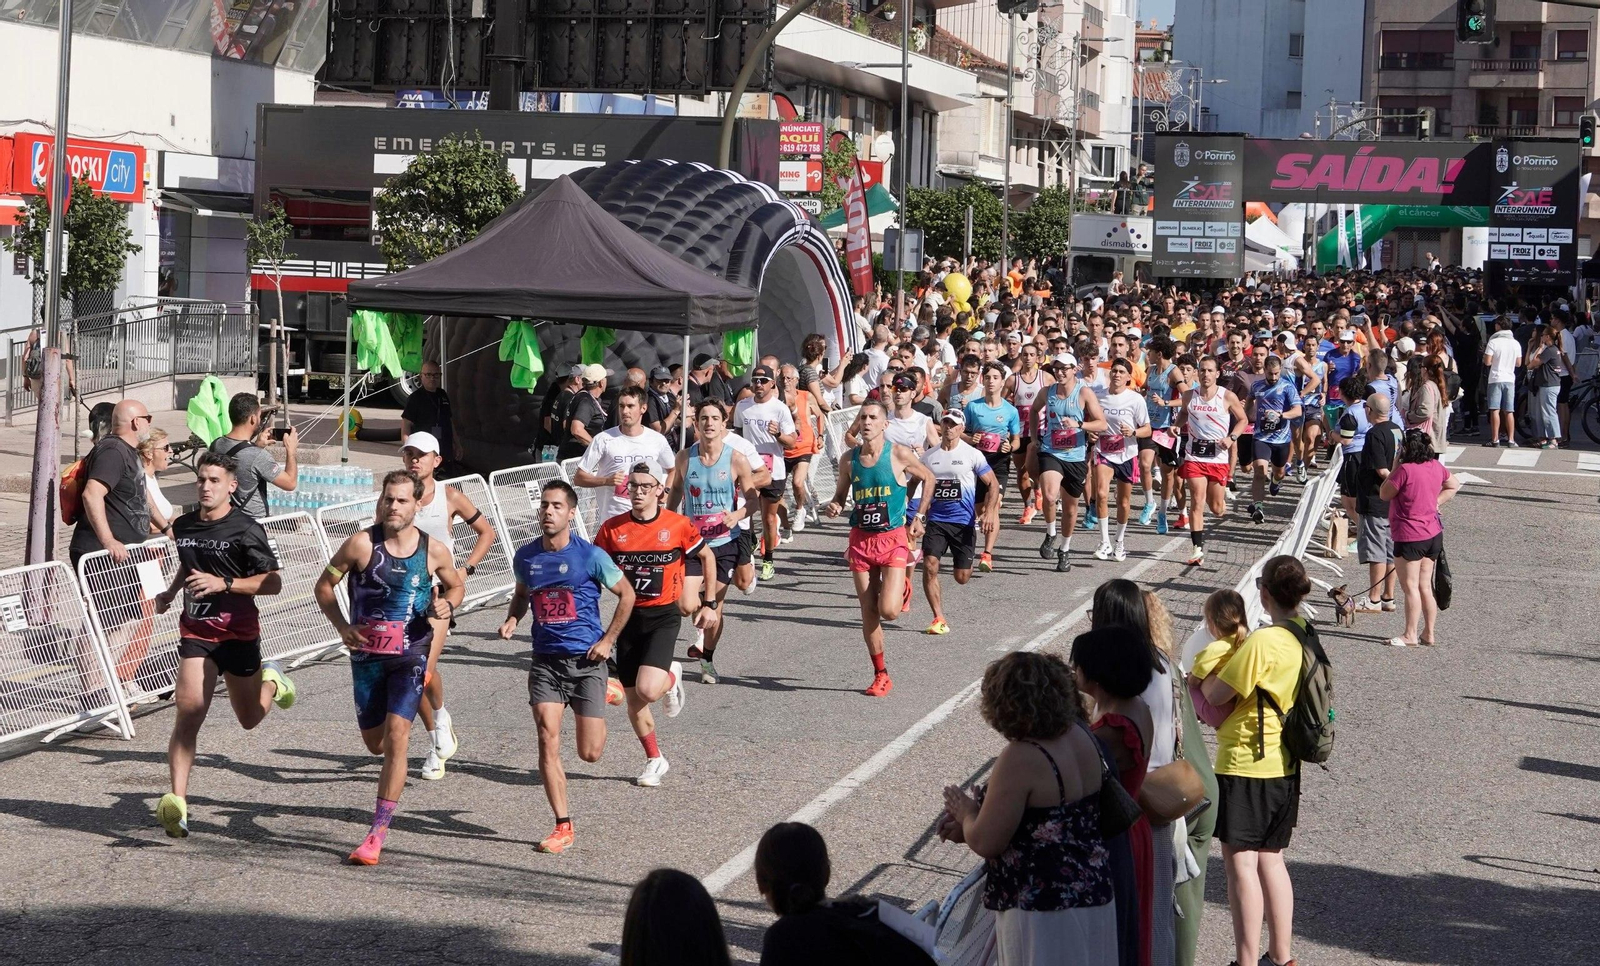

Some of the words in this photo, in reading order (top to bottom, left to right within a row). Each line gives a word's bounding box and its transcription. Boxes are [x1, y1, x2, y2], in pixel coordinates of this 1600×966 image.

[780, 133, 819, 144] AQUÍ
[783, 144, 795, 152] 619
[796, 144, 808, 152] 472
[808, 144, 820, 153] 758
[111, 158, 131, 189] city
[1271, 146, 1467, 194] SAÍDA!
[1507, 190, 1553, 206] CAE
[1175, 200, 1233, 208] INTERRUNNING
[1398, 208, 1408, 216] el
[1408, 208, 1440, 217] cáncer
[1496, 206, 1555, 214] INTERRUNNING
[1100, 239, 1141, 249] dismaboc
[1199, 446, 1207, 454] 3
[934, 488, 959, 498] 268
[862, 513, 881, 524] 98
[700, 525, 723, 536] 690
[634, 578, 652, 591] 17
[189, 602, 212, 615] 177
[541, 603, 567, 617] 528
